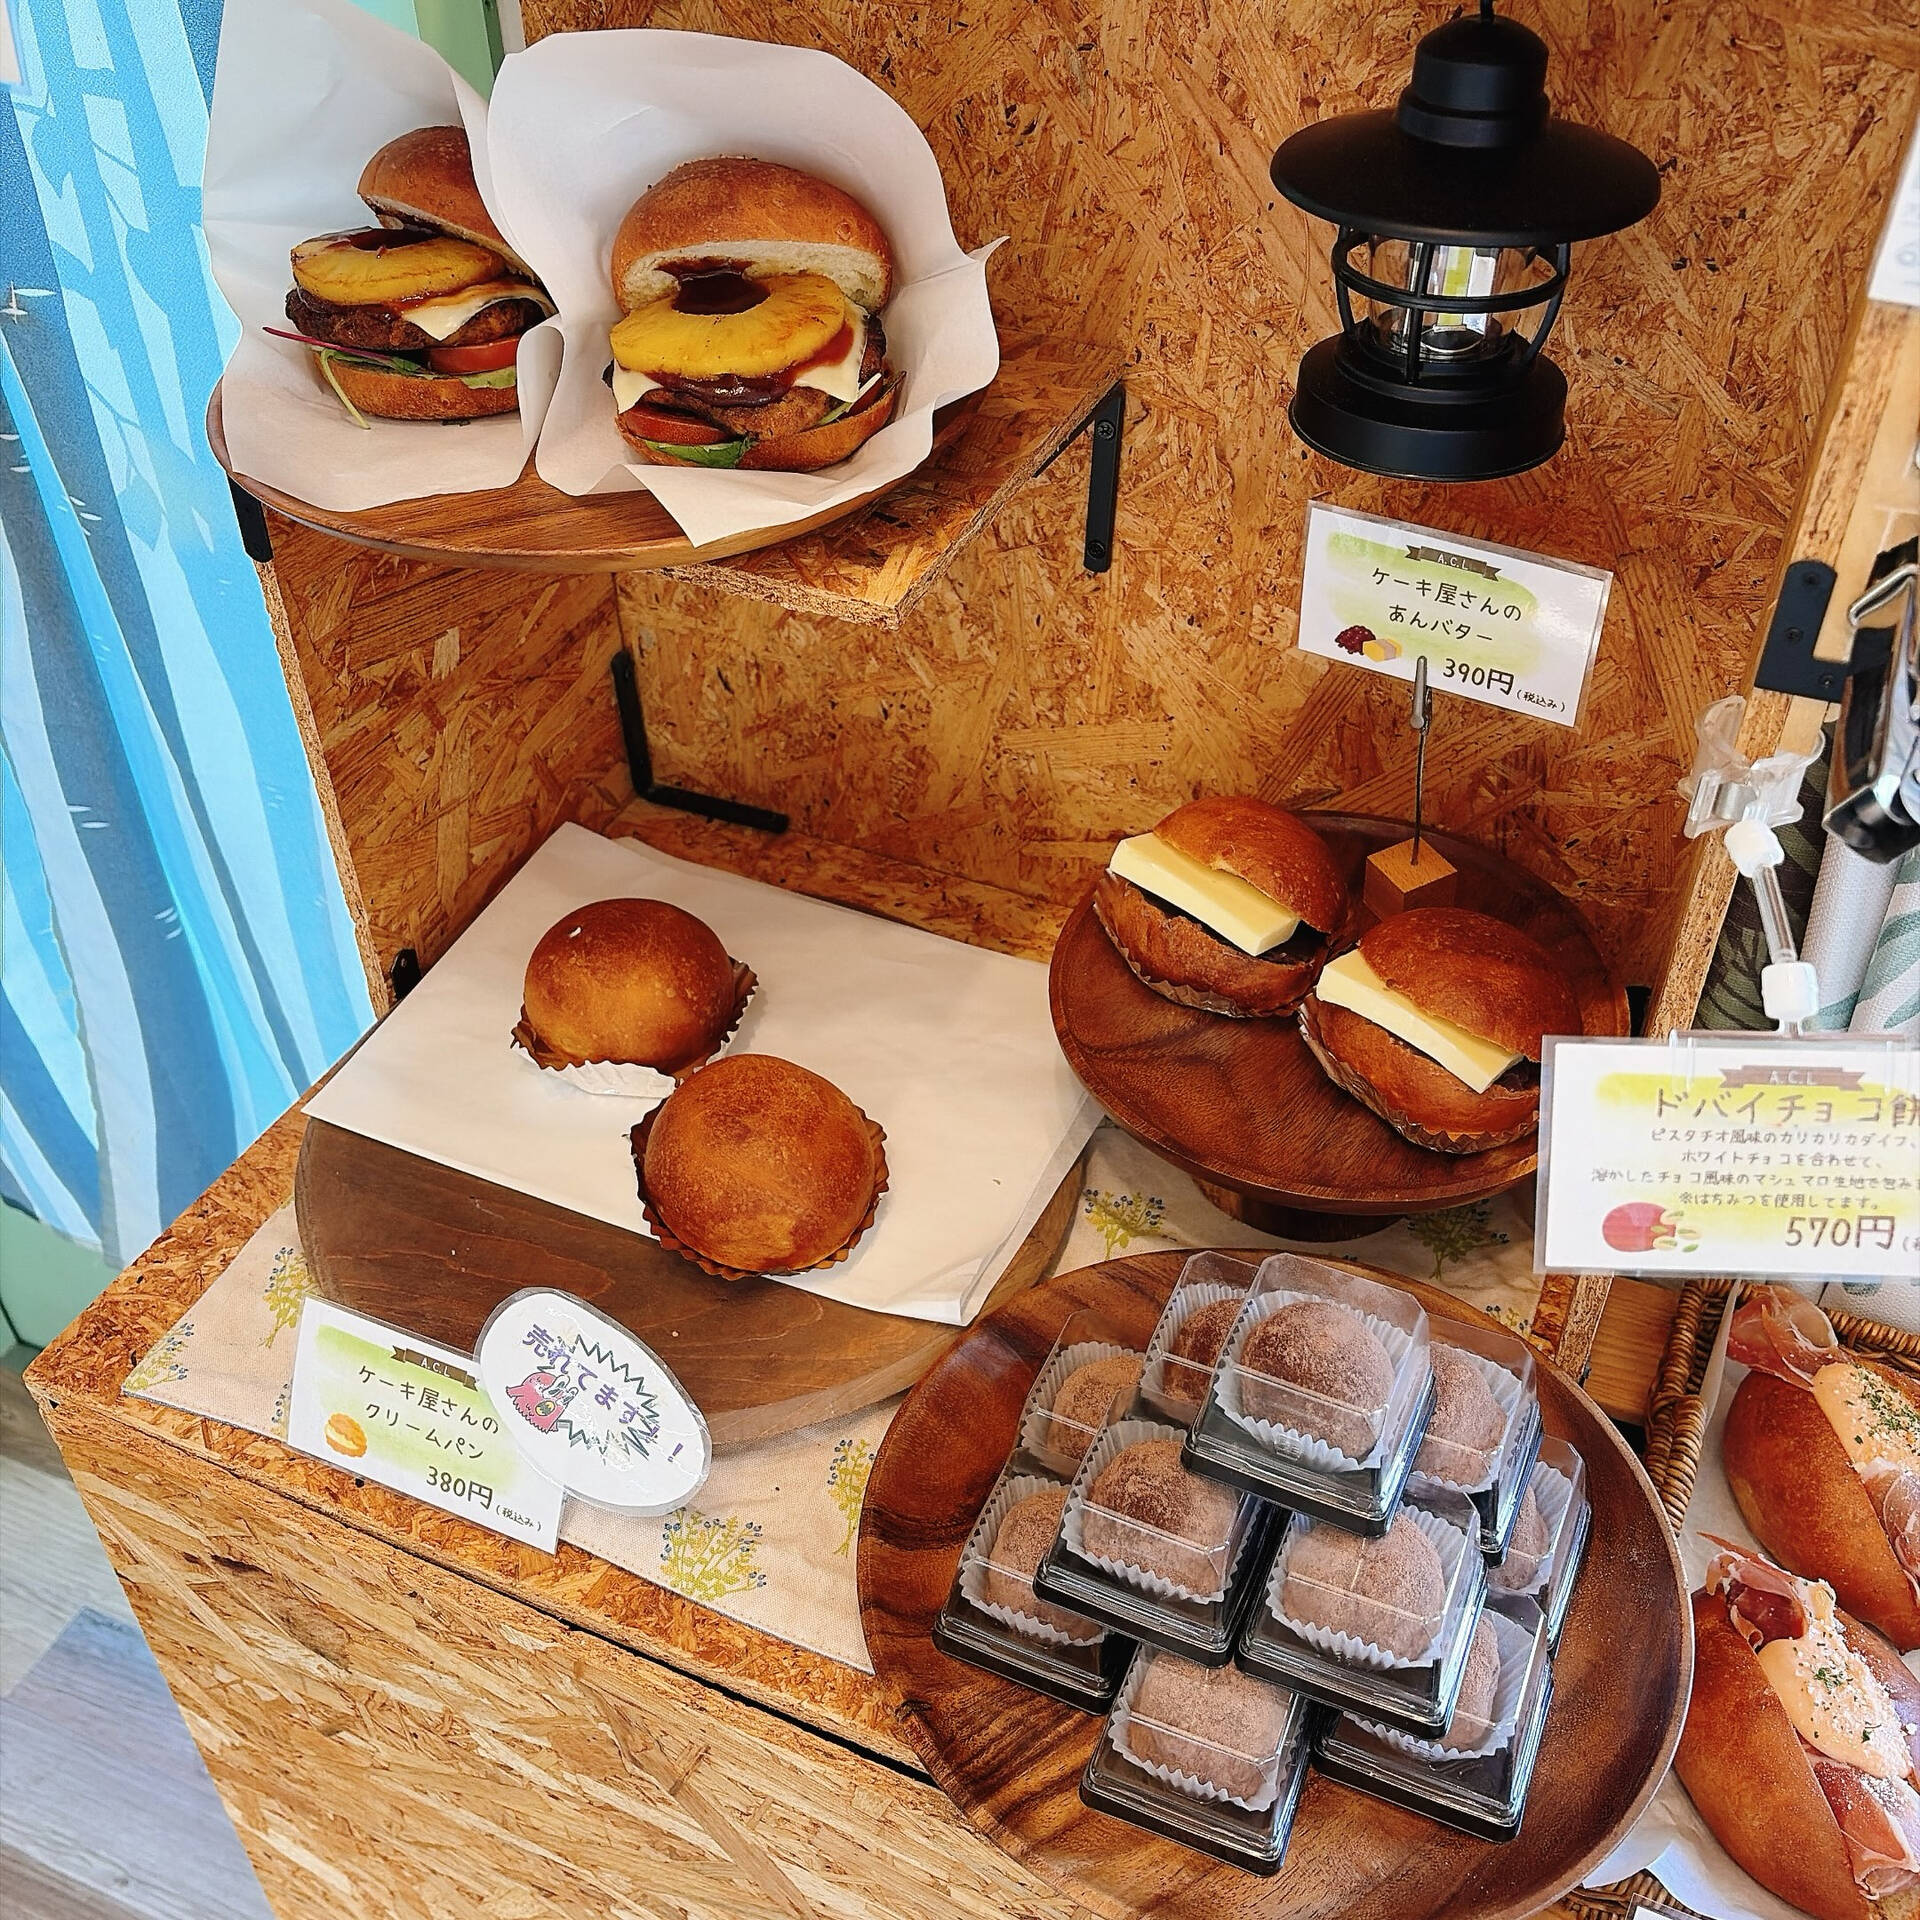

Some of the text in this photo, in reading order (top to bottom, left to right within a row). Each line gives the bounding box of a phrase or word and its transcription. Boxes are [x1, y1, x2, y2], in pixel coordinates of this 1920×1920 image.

[1371, 567, 1522, 622] ケーキ屋さんの
[1388, 603, 1493, 641] あんバター
[1442, 658, 1515, 696] 390円
[1591, 1167, 1920, 1190] 溶かしたチョコ風味のマシュマロ生地で包み
[1785, 1215, 1896, 1250] 570円
[358, 1365, 499, 1434] ケーキ屋さんの
[366, 1403, 484, 1459] クリームパン
[426, 1465, 494, 1510] 380円
